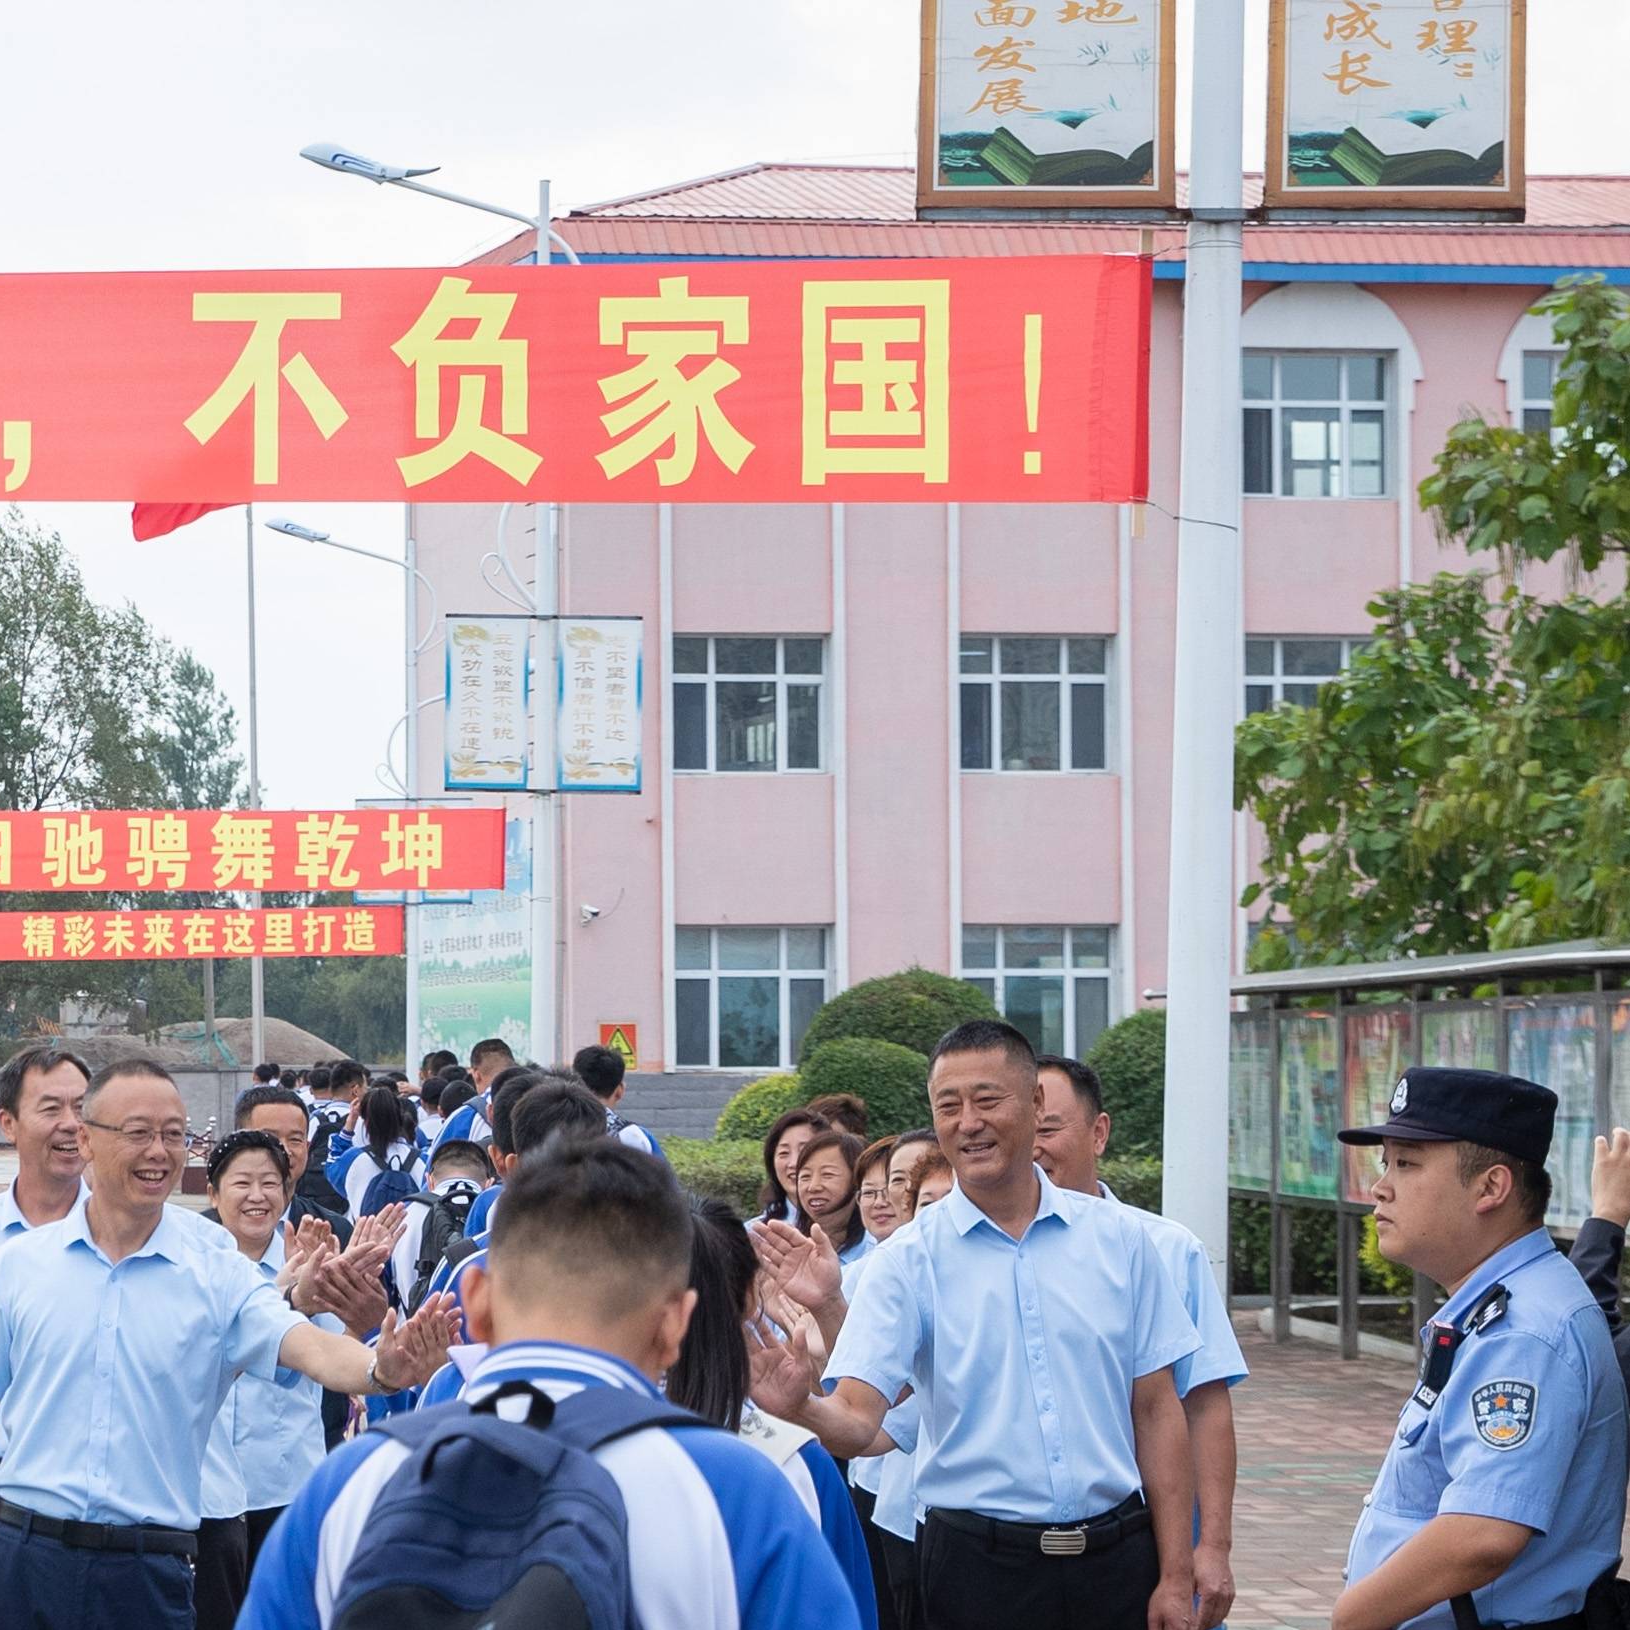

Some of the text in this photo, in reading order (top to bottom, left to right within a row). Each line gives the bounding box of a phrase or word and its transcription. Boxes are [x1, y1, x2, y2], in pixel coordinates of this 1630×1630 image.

[1322, 3, 1392, 96] 成长
[22, 912, 377, 958] 精彩未来在这里打造
